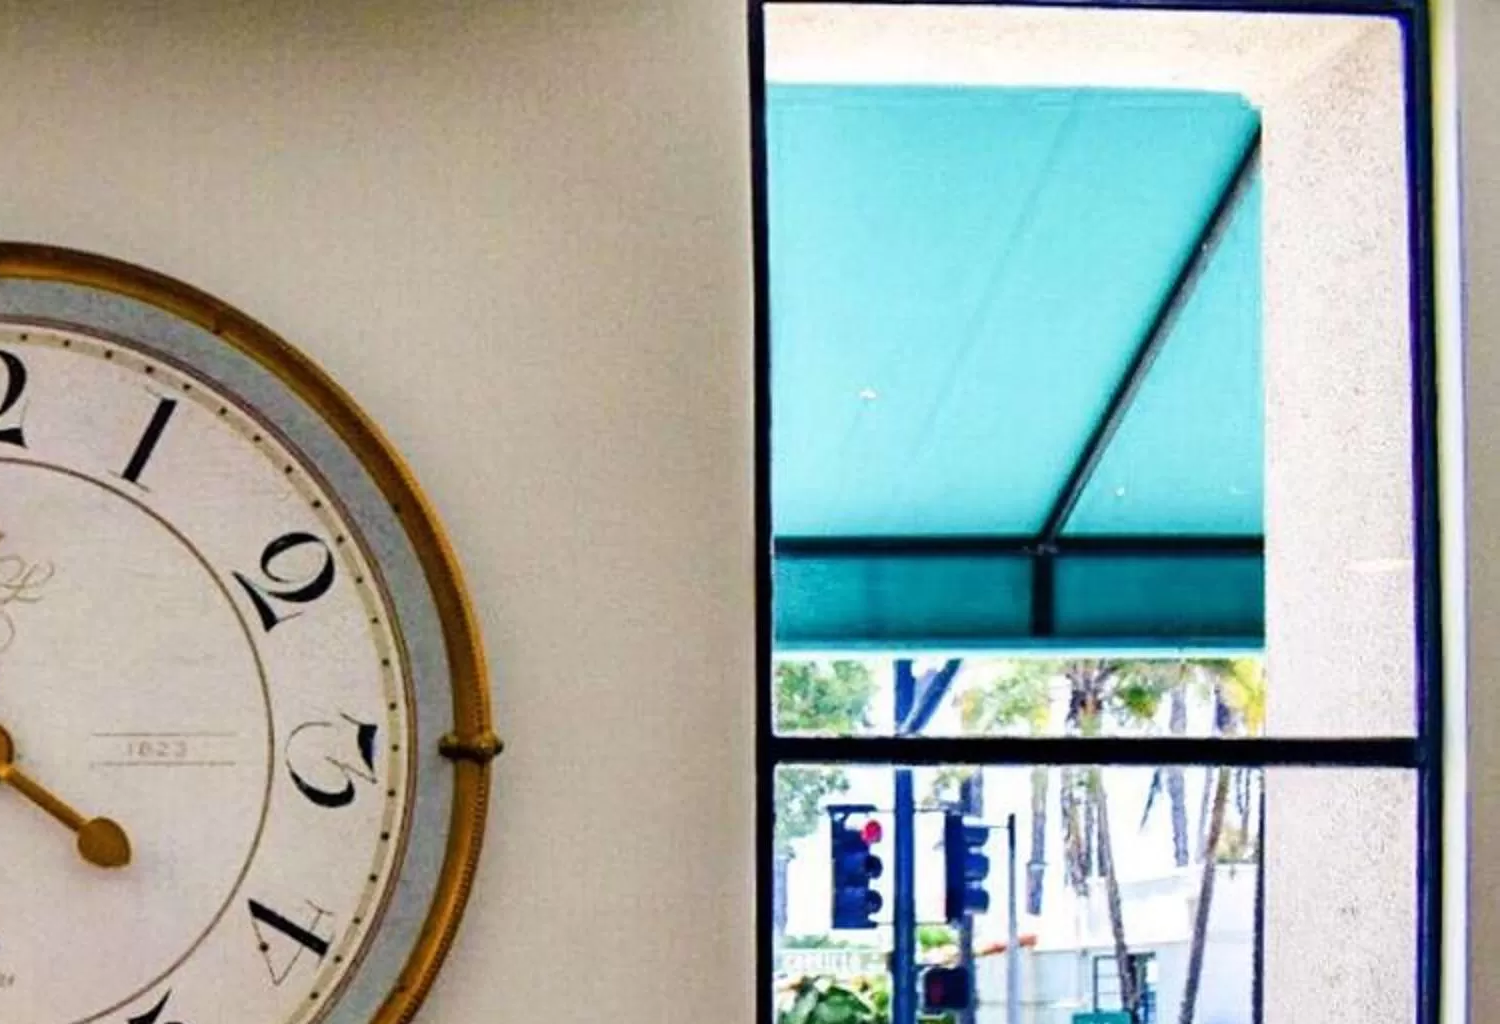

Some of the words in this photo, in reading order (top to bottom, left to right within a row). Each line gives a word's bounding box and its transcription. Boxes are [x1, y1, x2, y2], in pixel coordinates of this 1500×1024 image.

[111, 397, 176, 492] 1
[233, 530, 338, 633] 2
[284, 712, 379, 808] 3
[247, 897, 336, 987] 4
